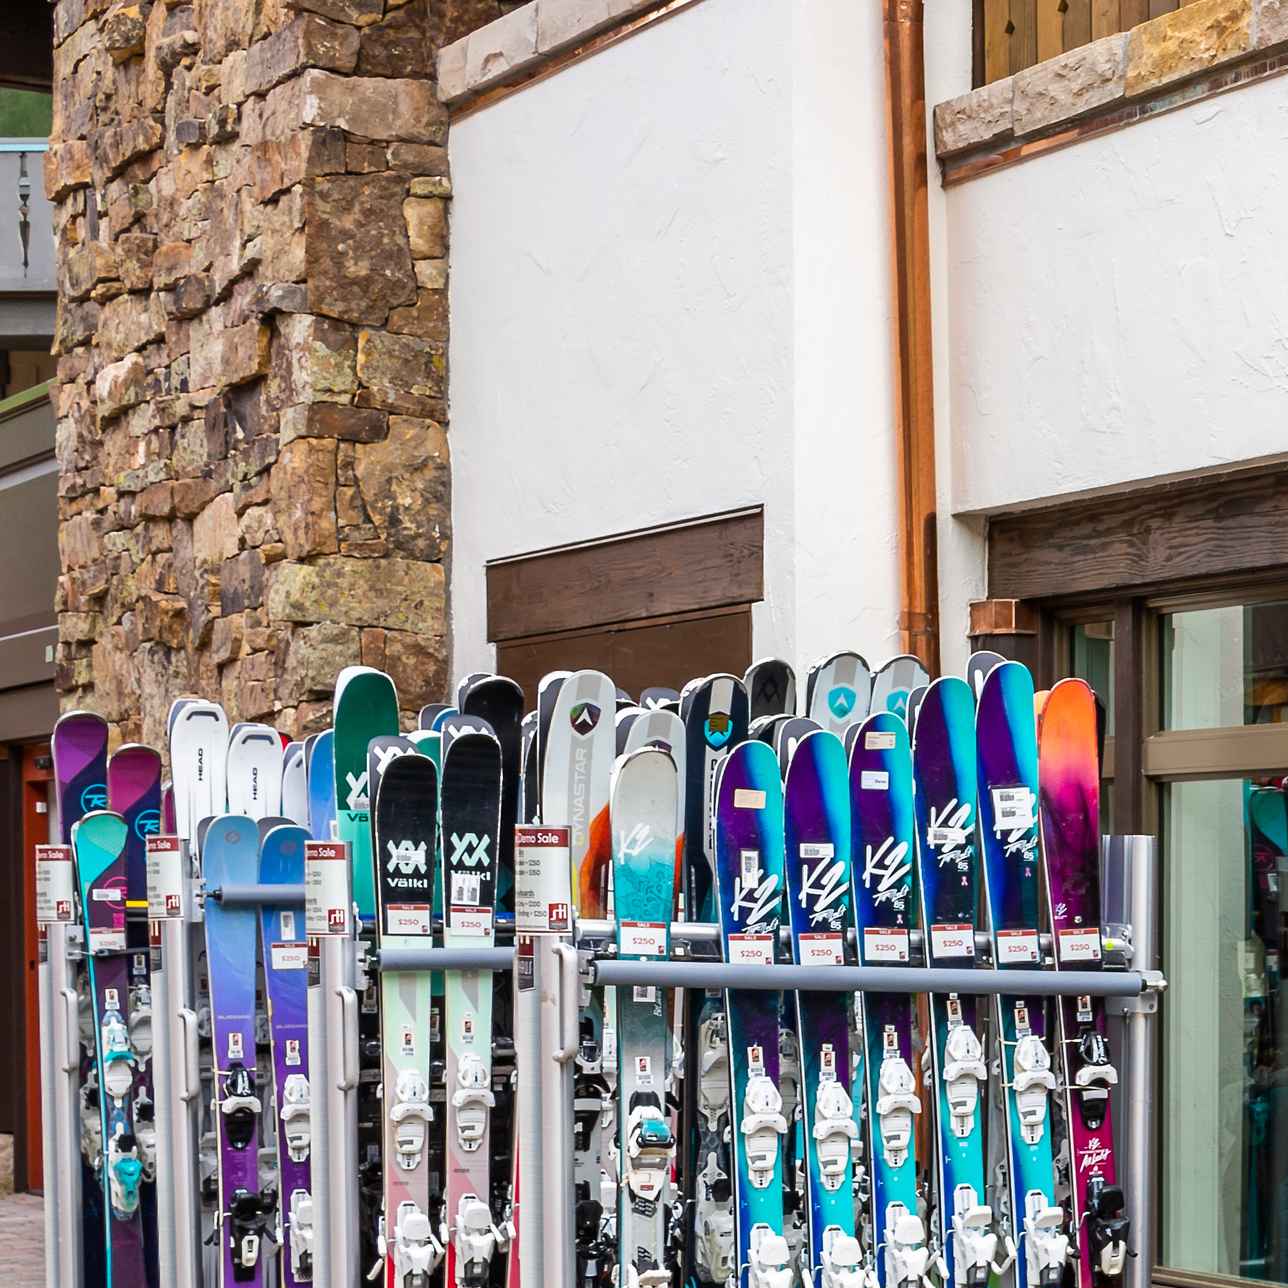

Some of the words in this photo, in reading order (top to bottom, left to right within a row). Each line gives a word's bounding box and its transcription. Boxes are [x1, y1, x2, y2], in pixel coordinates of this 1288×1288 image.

[572, 749, 589, 848] DYNASTAR
[537, 832, 560, 844] Sale
[318, 847, 337, 858] Sale
[862, 835, 913, 892] K2
[387, 877, 428, 889] Völkl
[798, 856, 850, 912] K2
[730, 868, 783, 925] K2
[632, 937, 656, 945] $250
[941, 939, 964, 948] $250
[810, 949, 833, 957] $250
[874, 944, 897, 952] $250
[740, 950, 763, 958] $250
